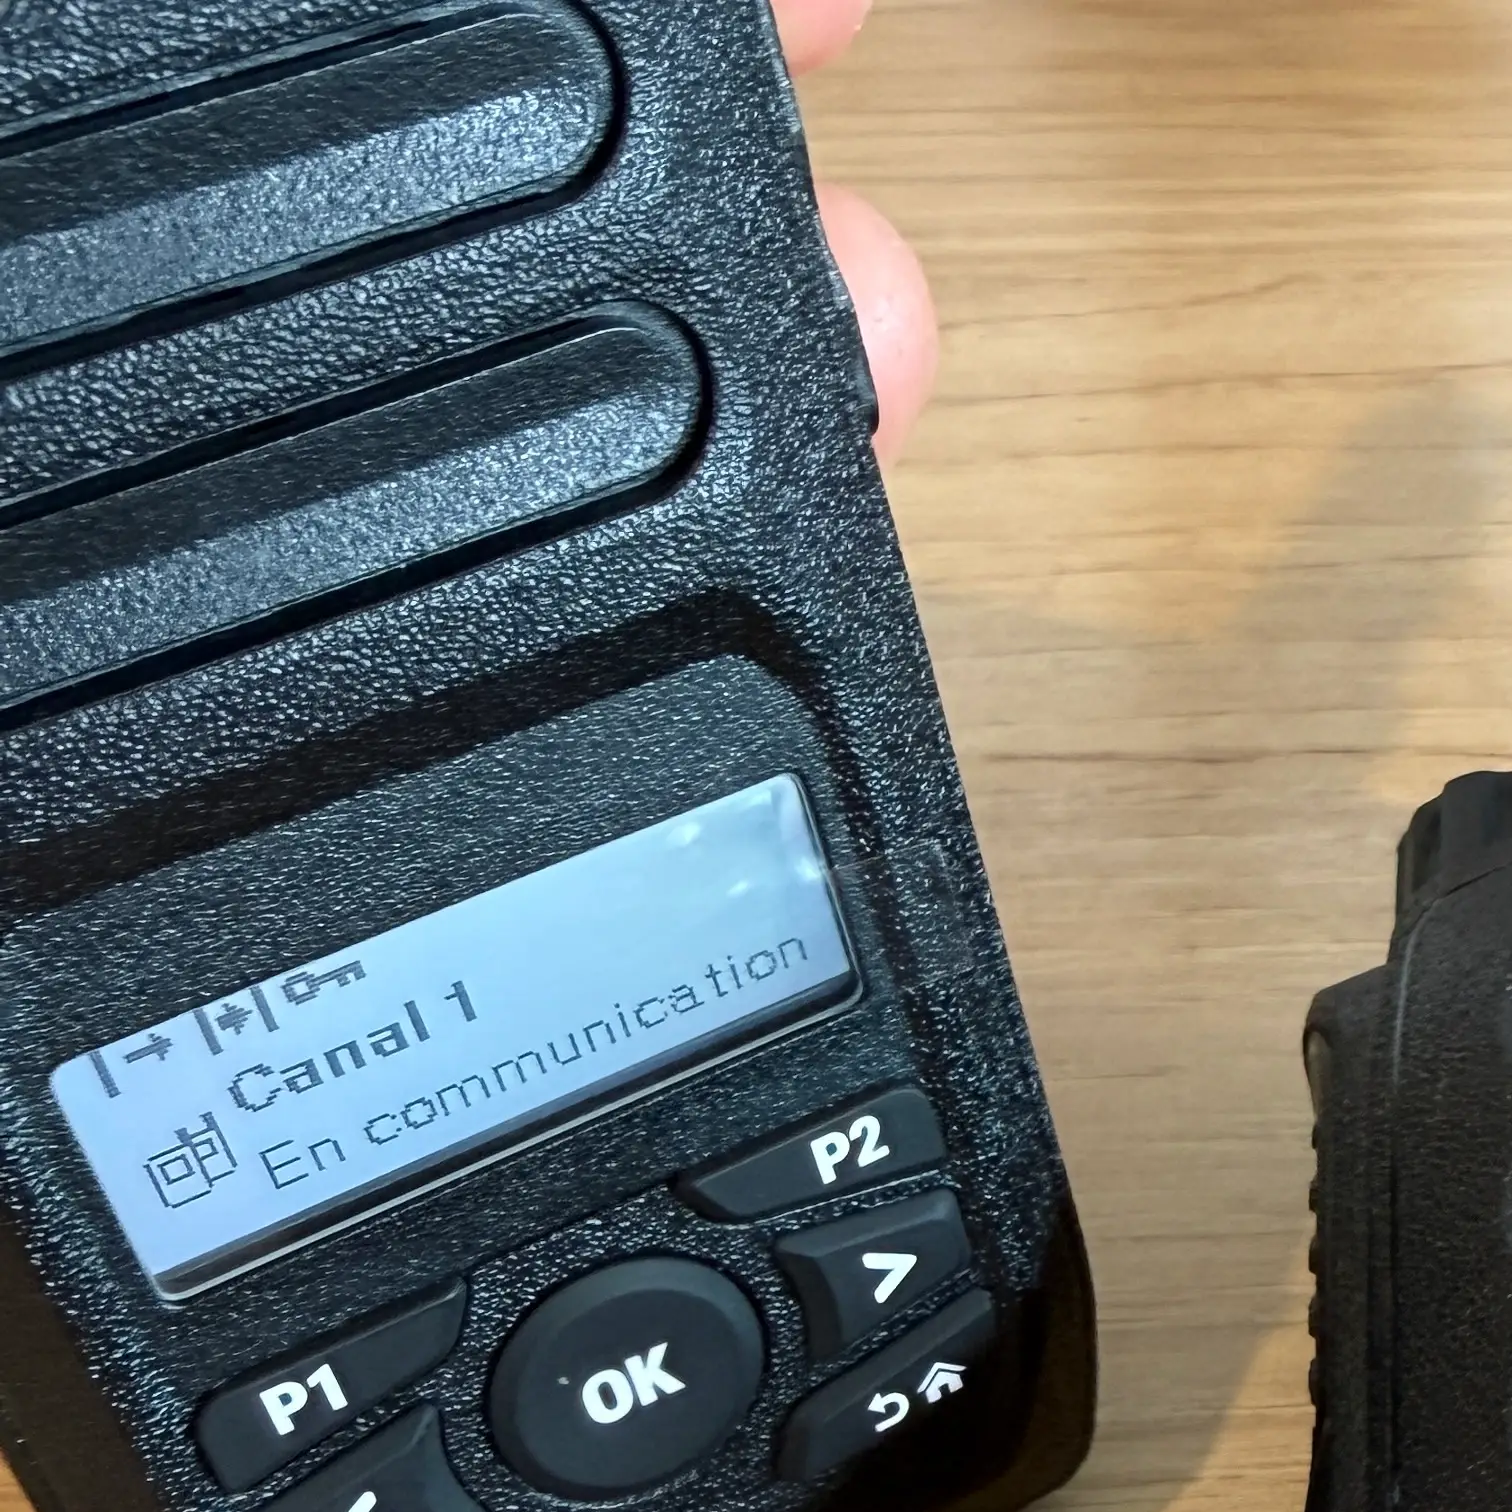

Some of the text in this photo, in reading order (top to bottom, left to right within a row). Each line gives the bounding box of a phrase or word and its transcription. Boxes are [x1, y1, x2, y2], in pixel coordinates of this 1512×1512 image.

[227, 980, 479, 1113] Canal 1
[258, 935, 810, 1192] En communication
[809, 1114, 892, 1185] P2
[258, 1364, 349, 1437] P1
[580, 1341, 687, 1425] OK
